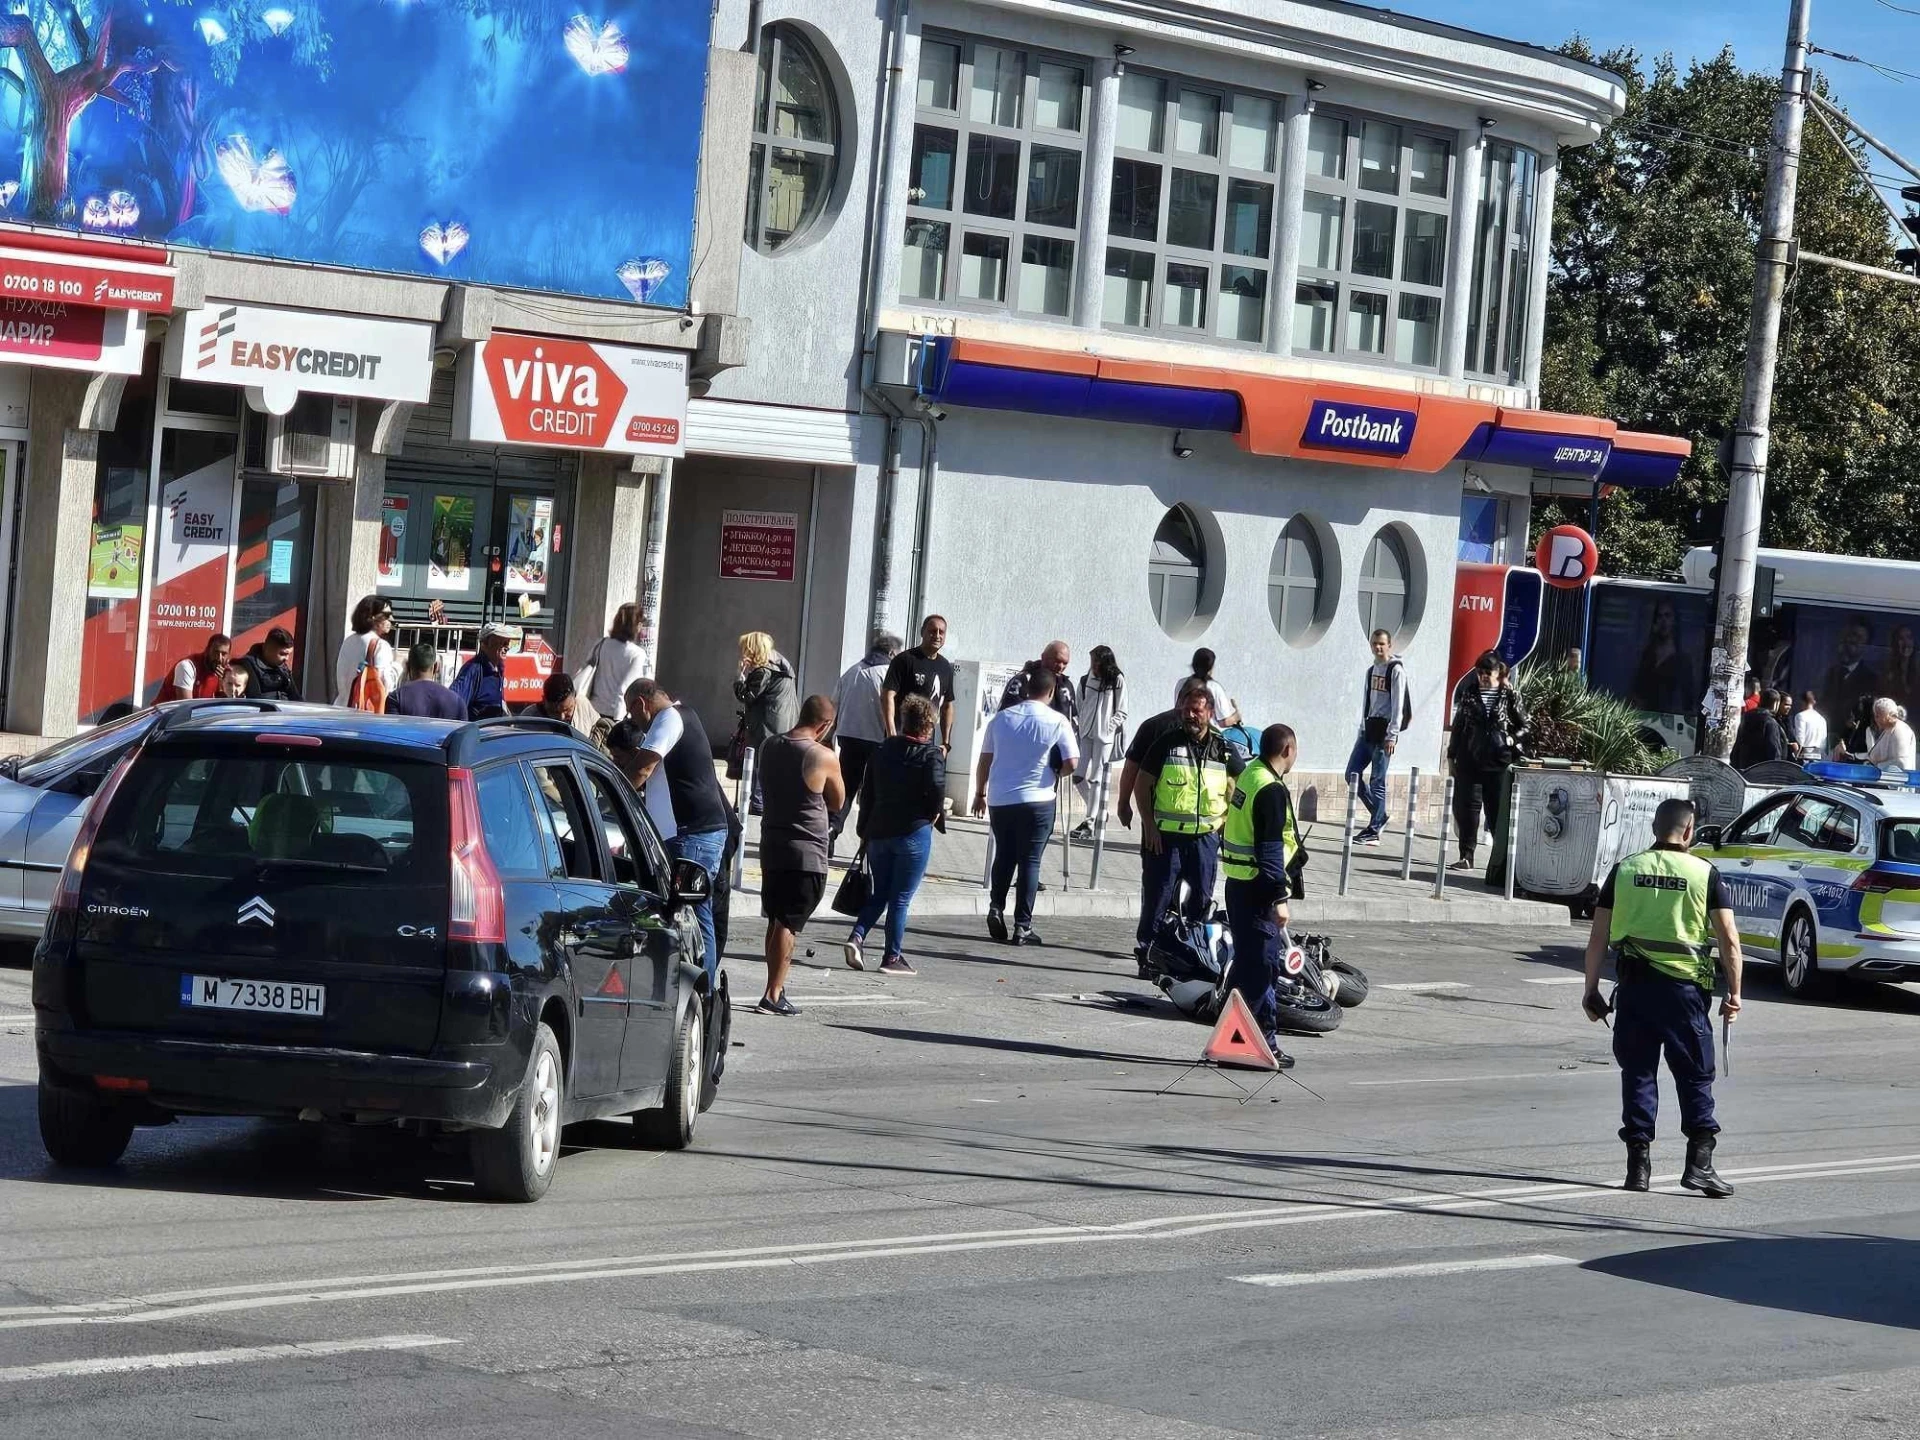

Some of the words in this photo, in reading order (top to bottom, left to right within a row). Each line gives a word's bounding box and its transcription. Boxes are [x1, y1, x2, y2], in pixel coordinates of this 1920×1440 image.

[4, 274, 39, 291] 0700
[42, 279, 55, 293] 18
[59, 280, 83, 296] 100
[108, 288, 163, 302] EASYCREDIT
[6, 298, 67, 319] НУЖДА
[0, 319, 55, 346] АРИ?
[231, 340, 381, 380] EASYCREDIT
[502, 347, 599, 407] viva
[530, 408, 597, 436] CREDIT
[632, 421, 651, 432] 0700
[652, 423, 661, 432] 45
[662, 424, 676, 434] 245
[1320, 408, 1403, 444] Postbank
[1554, 447, 1591, 463] ЦЕНТЪР
[1590, 450, 1603, 464] ЗА
[184, 513, 215, 526] EASY
[183, 526, 223, 540] CREDIT
[158, 604, 182, 617] 0700
[185, 605, 196, 617] 18
[199, 606, 216, 618] 100
[1459, 595, 1494, 612] ATM
[157, 619, 215, 630] www.easycredit.bg
[508, 680, 519, 690] до
[520, 678, 529, 689] 75
[1635, 875, 1687, 890] POLICE
[87, 904, 149, 917] CITROËN
[397, 925, 437, 939] C4
[230, 982, 285, 1009] 7338
